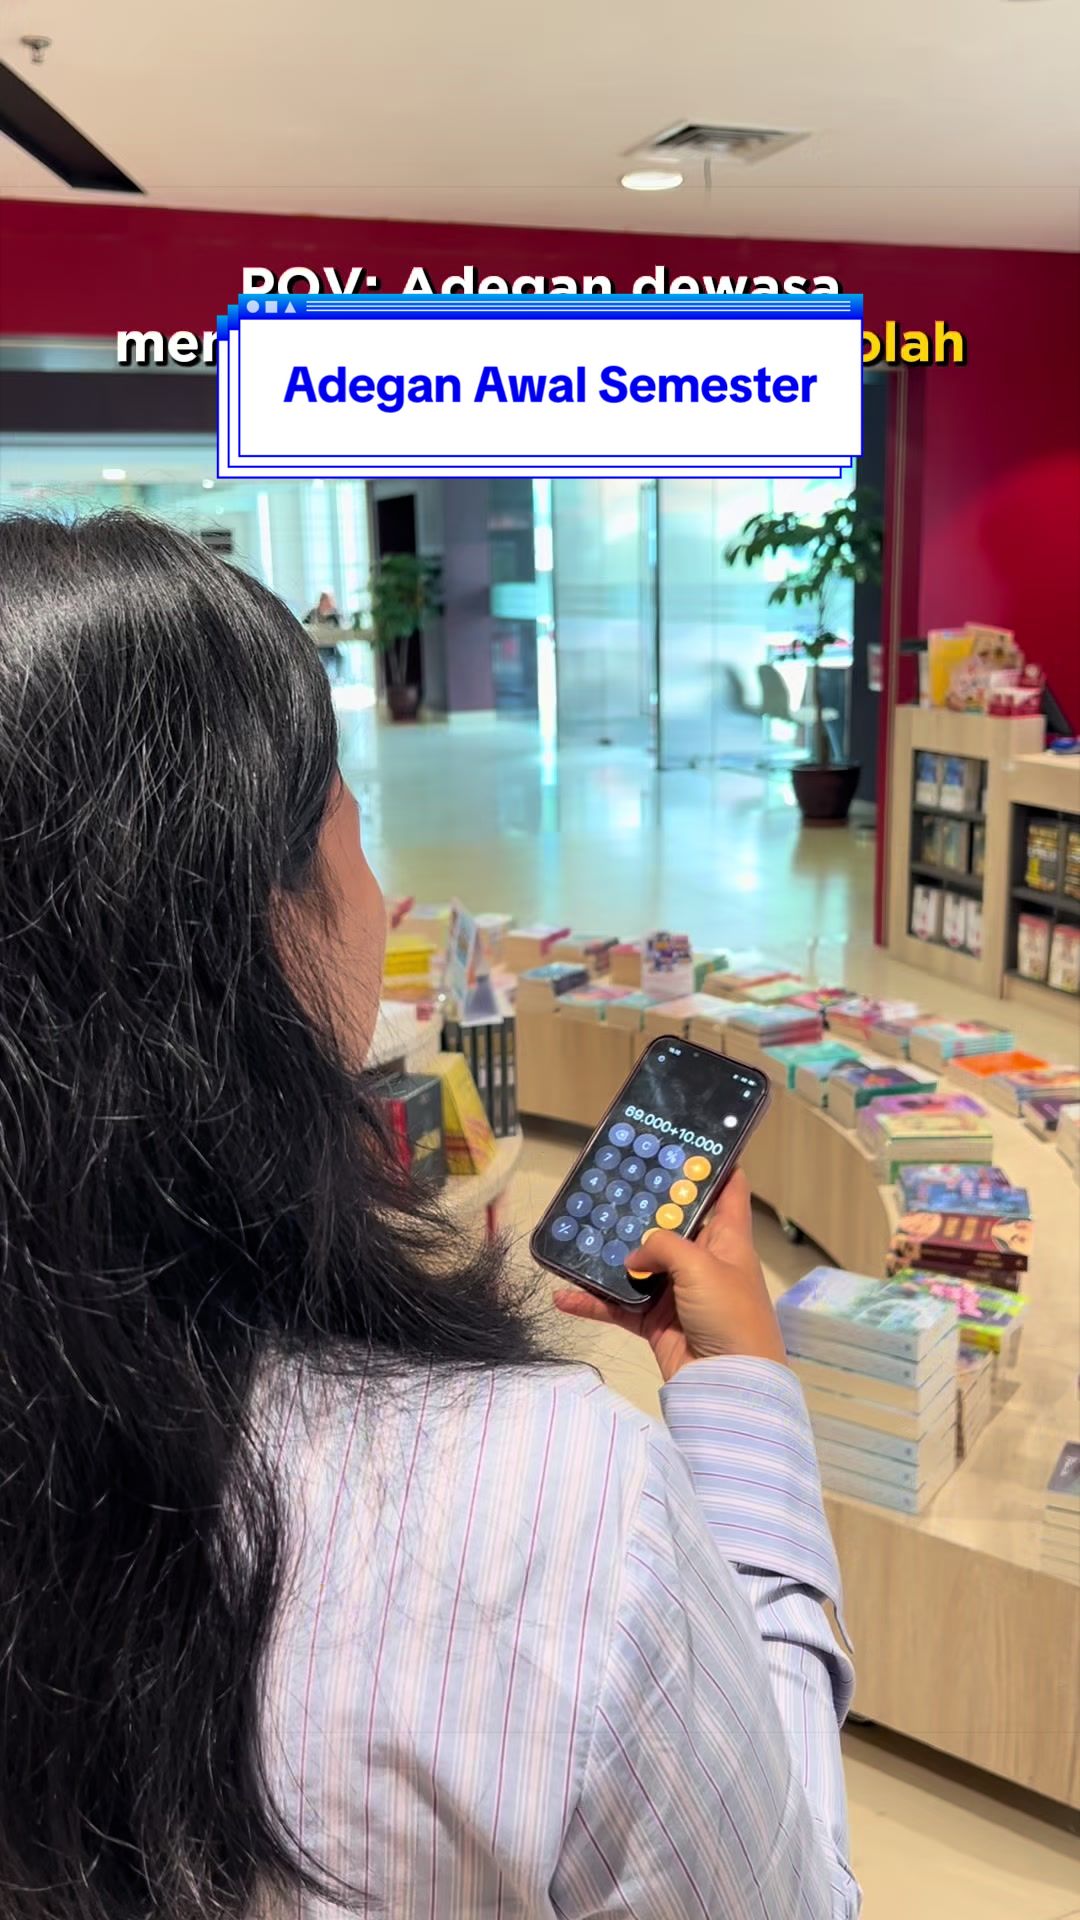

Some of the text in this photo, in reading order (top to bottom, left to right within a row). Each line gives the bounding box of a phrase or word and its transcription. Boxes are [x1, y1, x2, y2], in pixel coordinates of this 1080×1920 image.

[625, 1105, 723, 1156] 69.000+10.000
[641, 1141, 651, 1151] C
[603, 1153, 662, 1185] 7 8 9
[589, 1176, 648, 1209] 4 5 6
[576, 1200, 633, 1234] 1 2 3
[585, 1236, 594, 1246] 0
